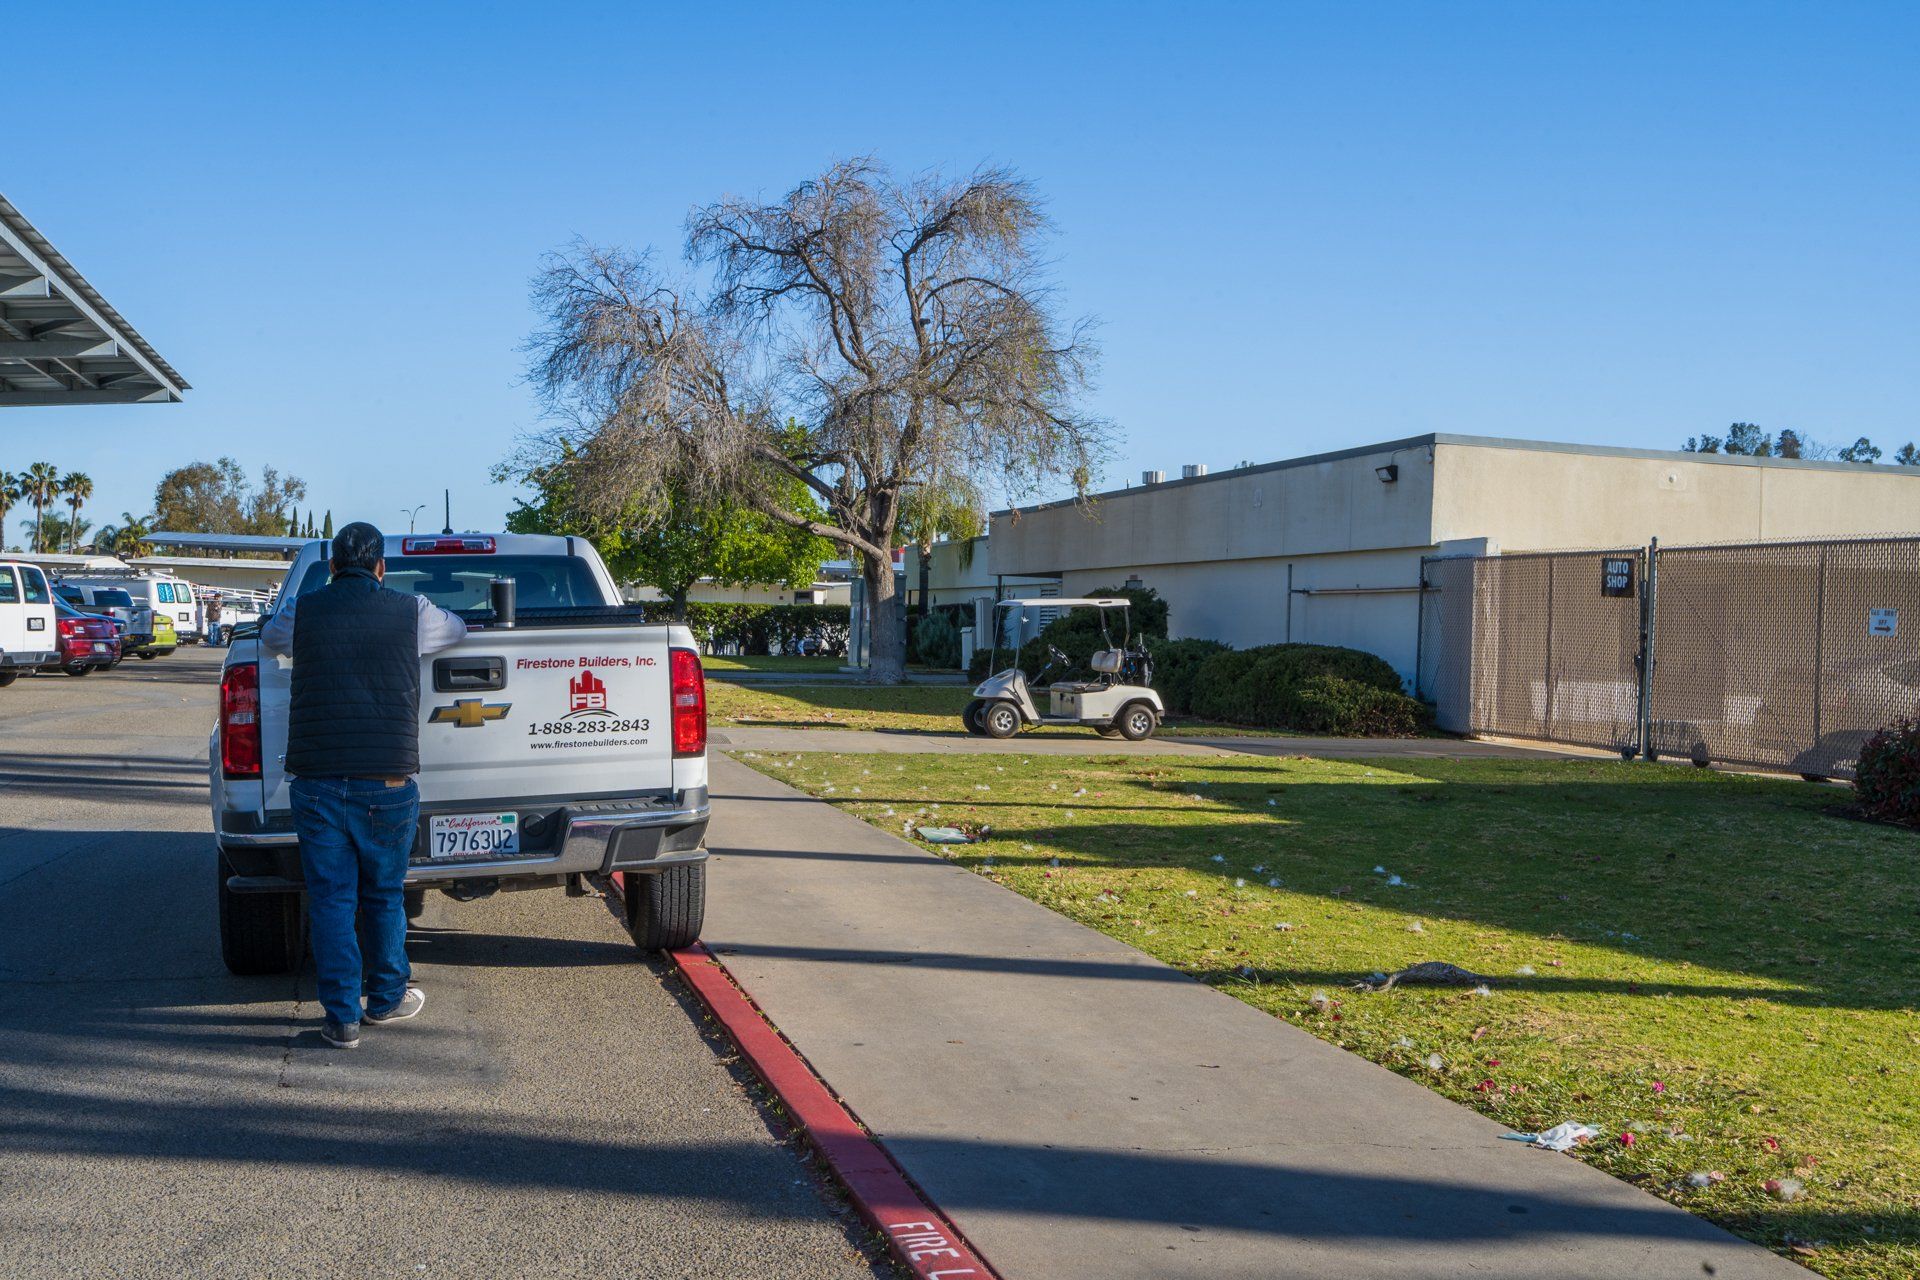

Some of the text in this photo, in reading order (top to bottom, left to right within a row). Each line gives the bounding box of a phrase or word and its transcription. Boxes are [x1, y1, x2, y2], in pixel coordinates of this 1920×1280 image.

[1607, 561, 1629, 574] AUTO
[1606, 575, 1628, 588] SHOP
[516, 655, 657, 669] Firestone Builders, Inc.
[571, 693, 605, 708] FB
[528, 719, 650, 735] 1-888-283-2843
[530, 738, 648, 749] www.firestonebuilders.com
[448, 817, 502, 830] California
[436, 829, 514, 853] 79763U2
[888, 1221, 960, 1261] FIRE
